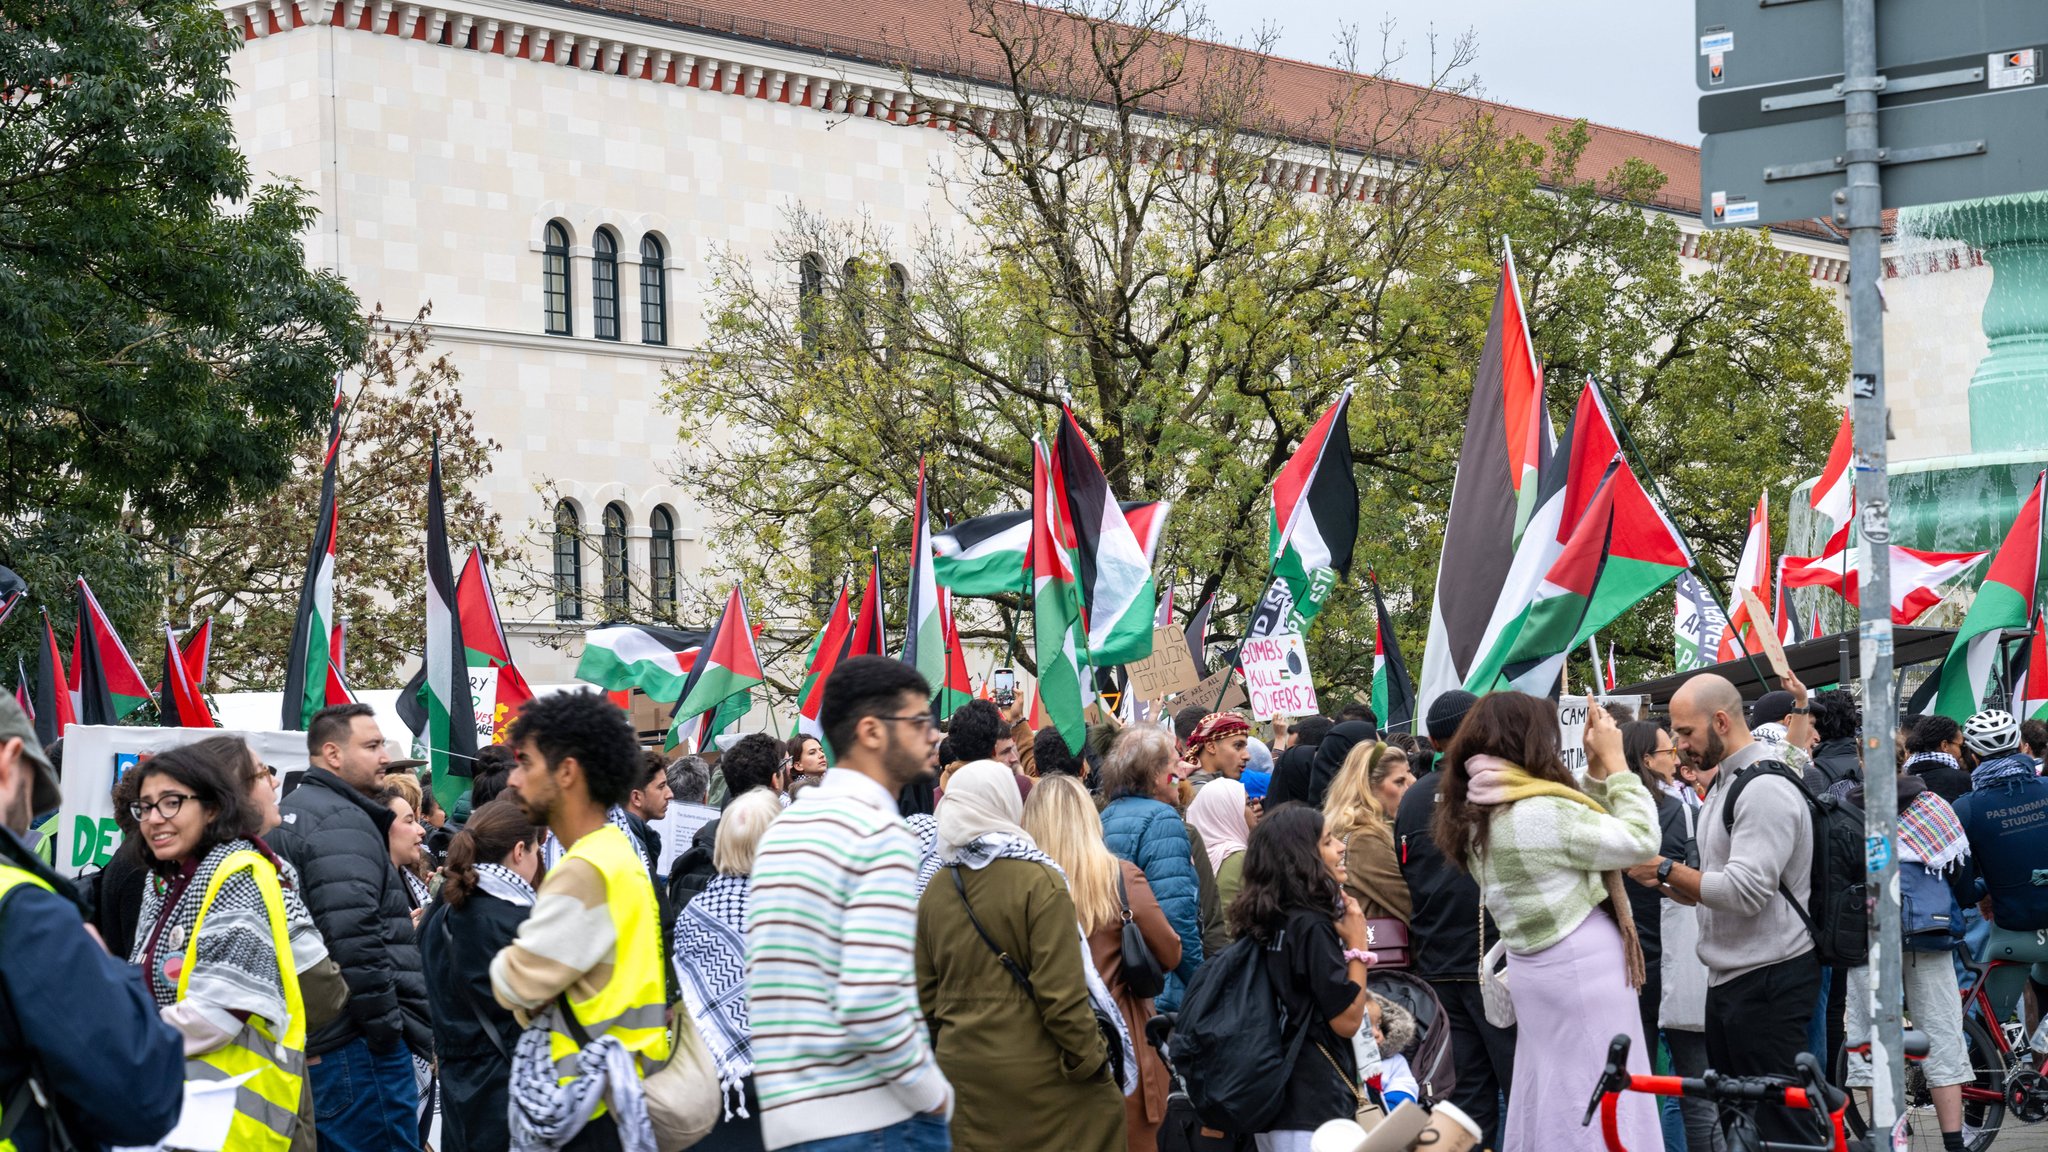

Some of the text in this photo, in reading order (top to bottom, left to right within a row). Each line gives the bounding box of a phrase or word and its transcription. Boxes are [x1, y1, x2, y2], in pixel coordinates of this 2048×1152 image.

[1248, 669, 1281, 688] KILL
[1172, 676, 1219, 706] WE ARE ALL
[1252, 685, 1302, 717] QUEERS
[1561, 706, 1590, 726] CAM
[1986, 809, 2007, 819] PAS
[2001, 811, 2046, 829] STUDIOS
[71, 814, 125, 868] DE
